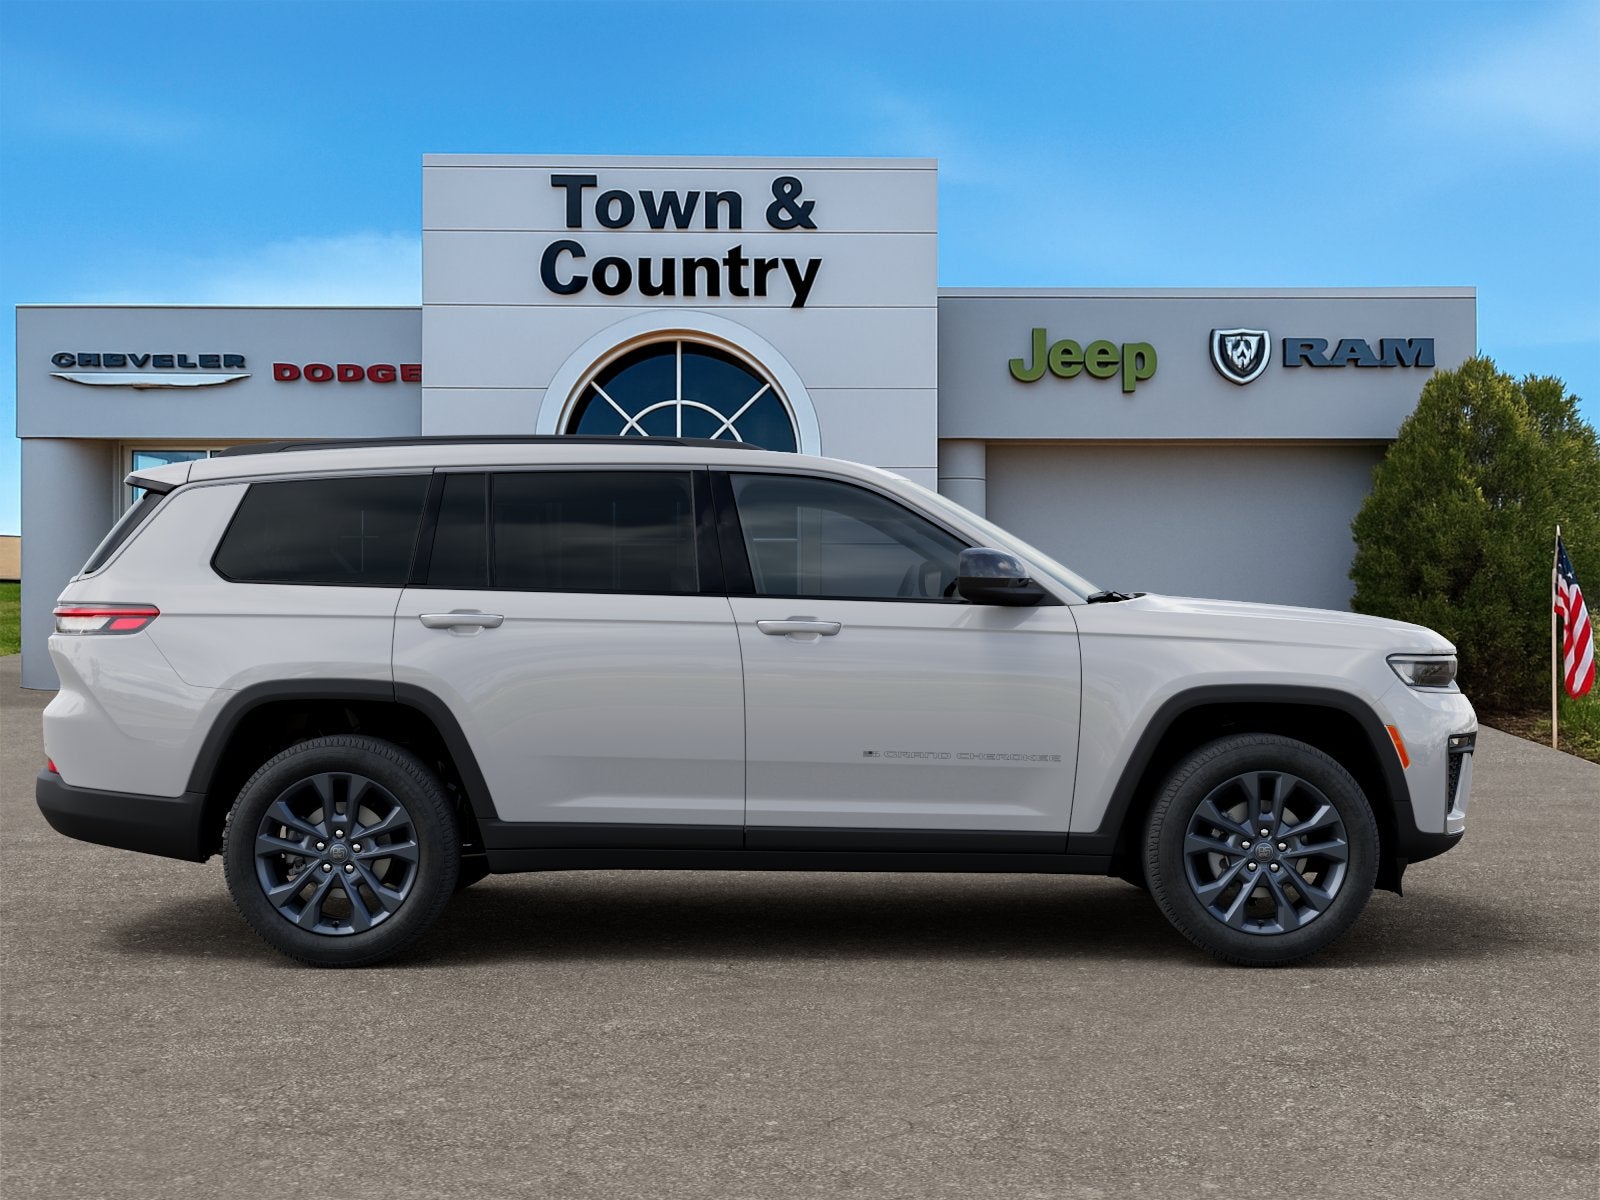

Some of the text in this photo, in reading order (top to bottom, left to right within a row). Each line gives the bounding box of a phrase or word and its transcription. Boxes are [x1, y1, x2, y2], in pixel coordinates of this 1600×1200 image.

[550, 174, 818, 230] Town &
[539, 239, 823, 309] Country
[272, 362, 422, 384] DODGE
[1008, 327, 1158, 393] Jeep
[1282, 337, 1436, 368] RAM
[883, 750, 1062, 762] GRAND CHEROKEE
